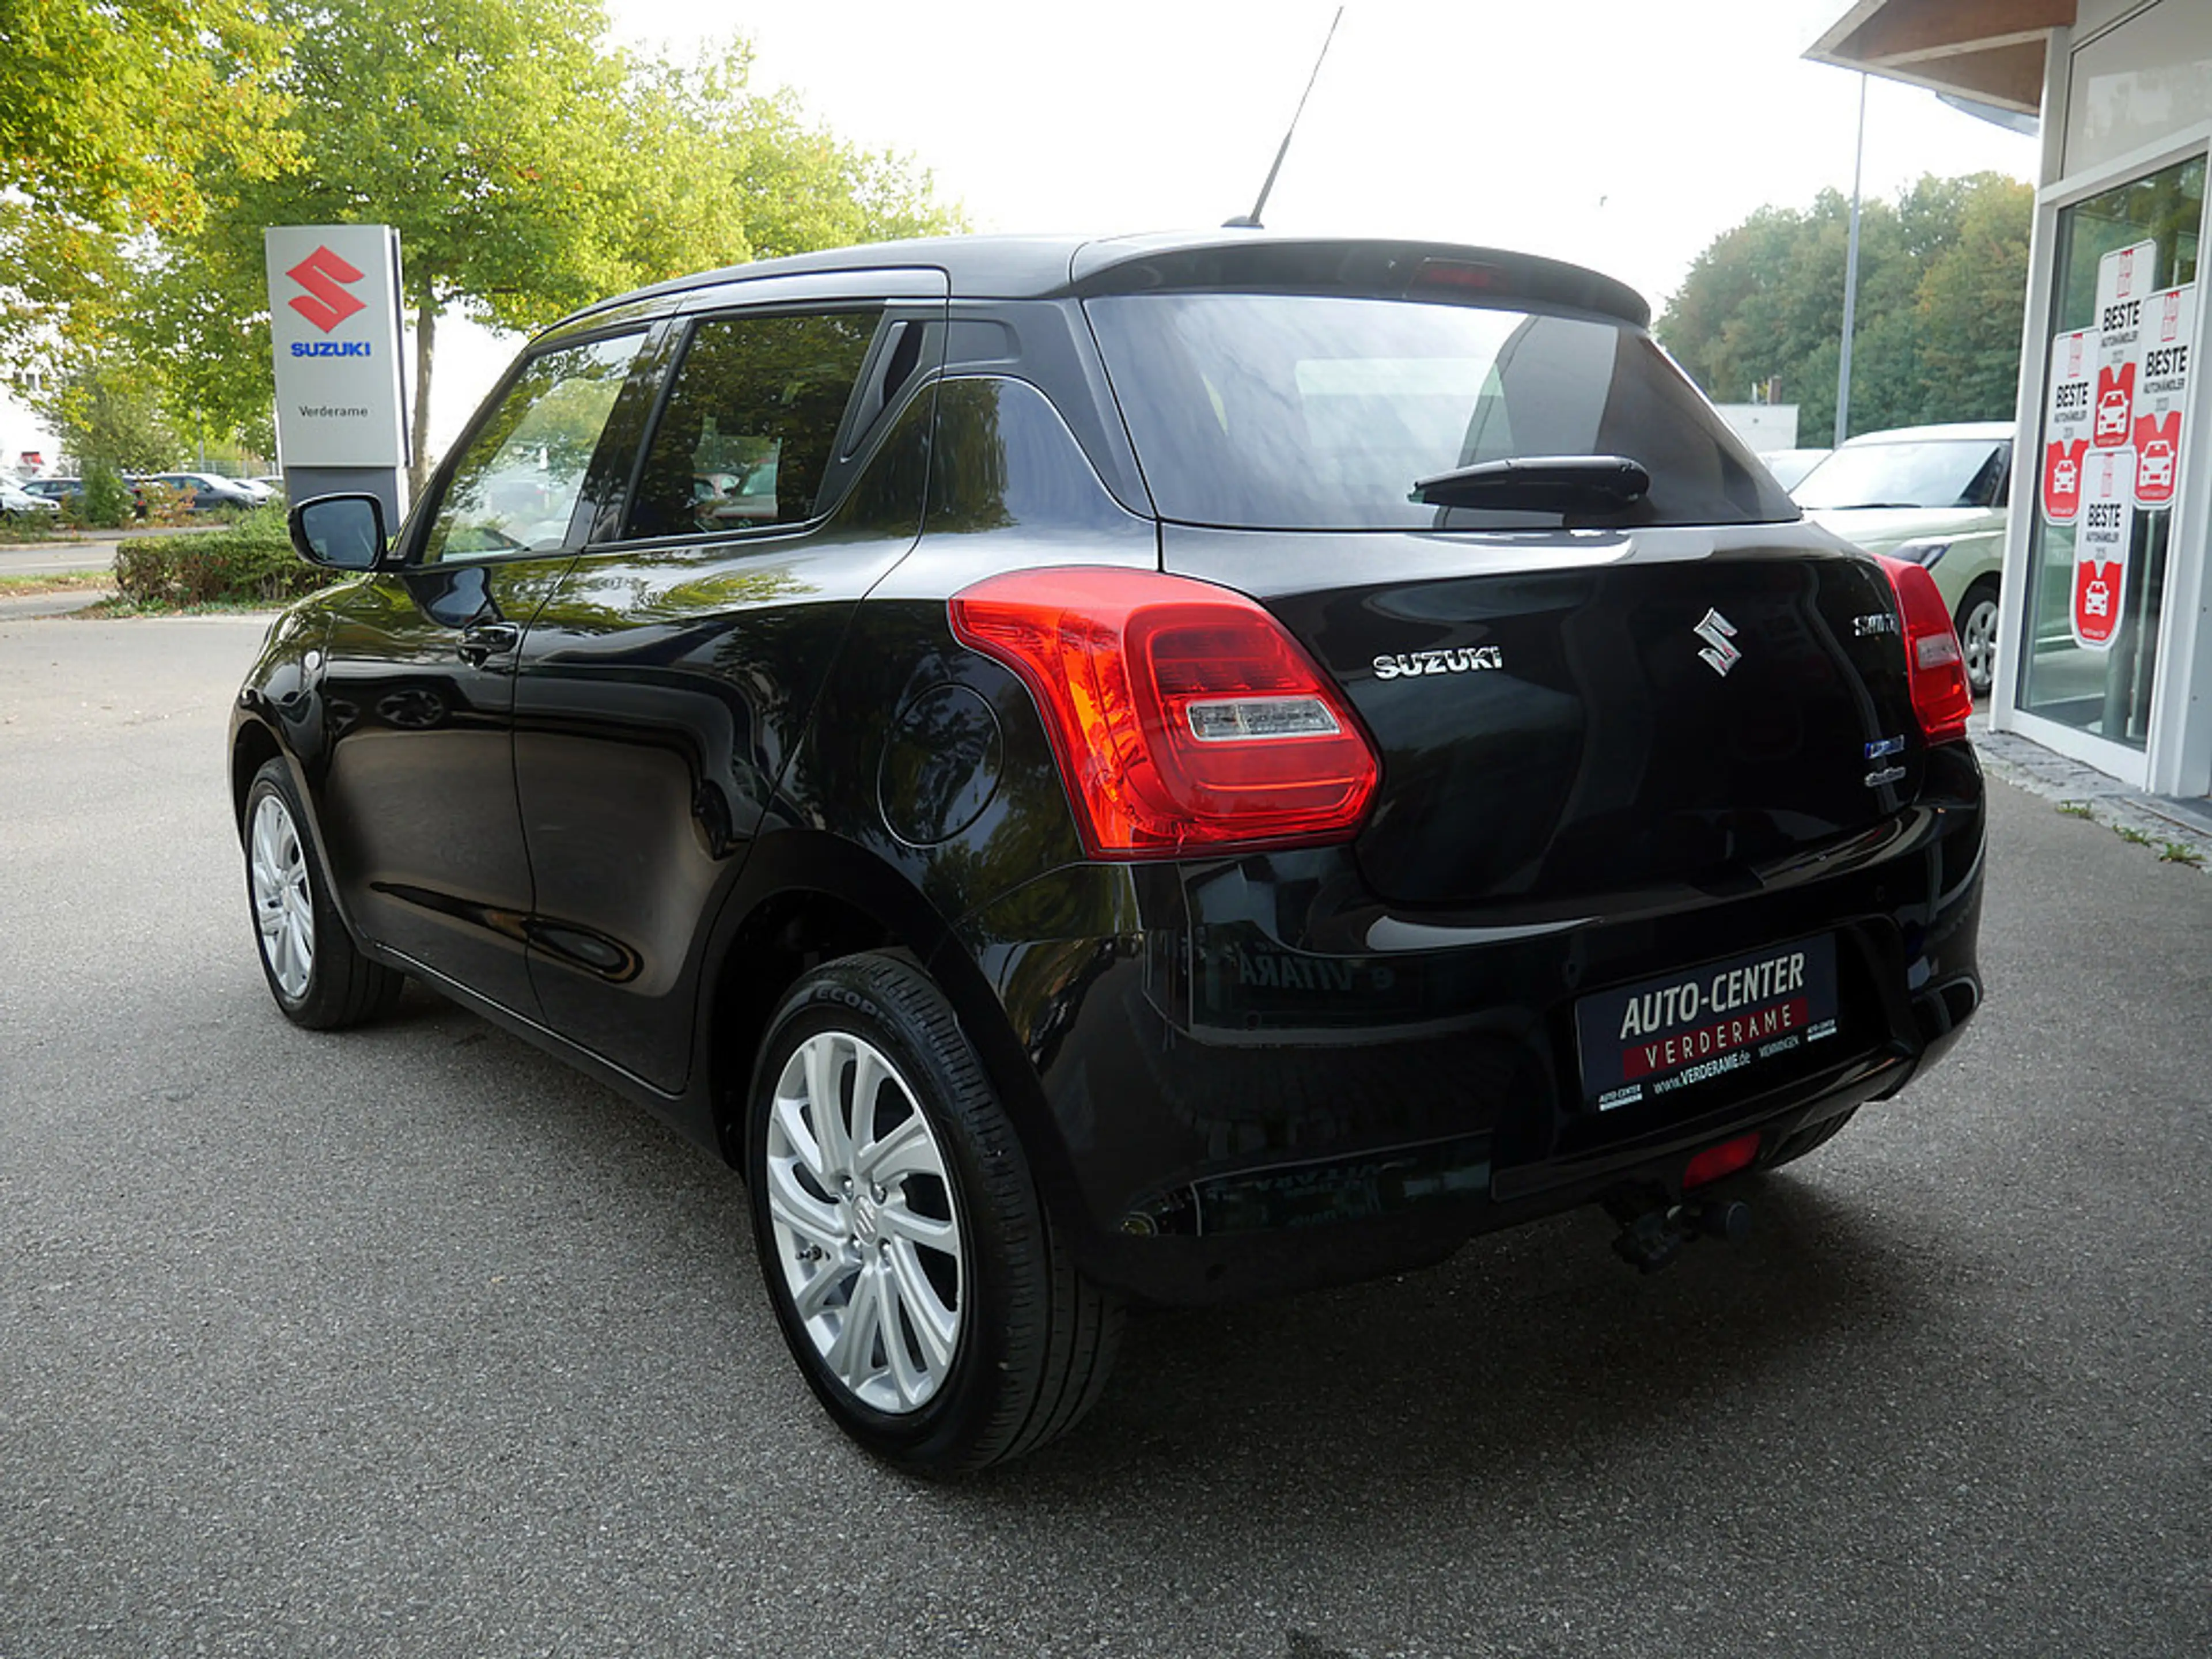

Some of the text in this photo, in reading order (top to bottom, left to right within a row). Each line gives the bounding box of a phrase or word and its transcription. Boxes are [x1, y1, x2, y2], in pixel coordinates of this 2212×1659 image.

[2103, 300, 2141, 332] BESTE
[290, 342, 372, 357] SUZUKI
[2145, 345, 2188, 378] BESTE
[2056, 381, 2089, 408] BESTE
[298, 406, 368, 418] Verderame
[2087, 502, 2122, 528] BESTE
[1373, 646, 1503, 680] SUZUKI
[1620, 952, 1805, 1040] AUTO-CENTER
[1645, 1005, 1792, 1069] VERDERAME
